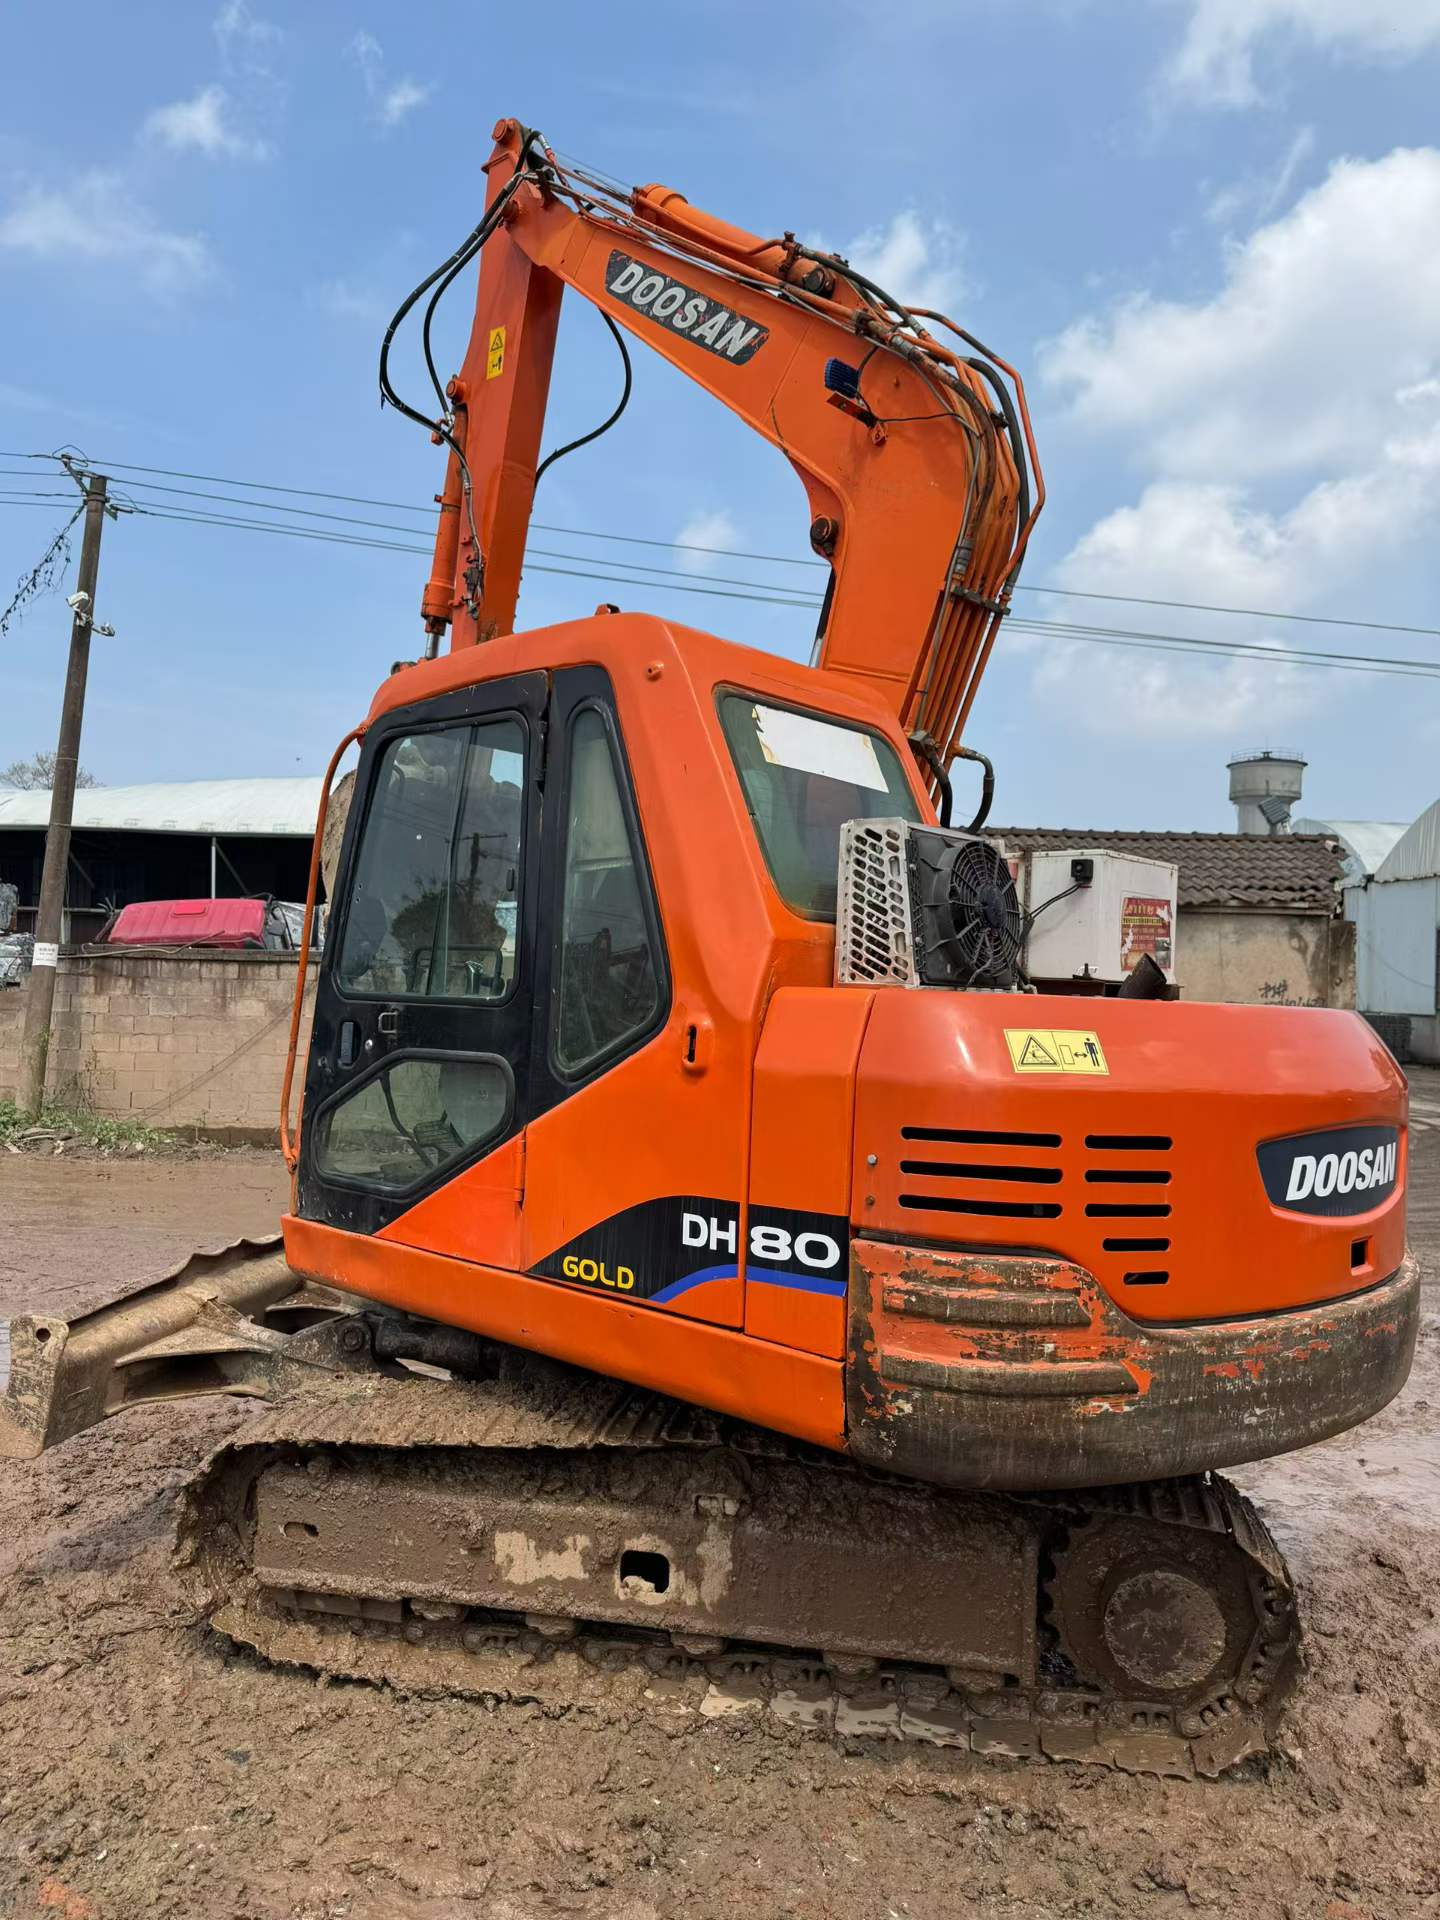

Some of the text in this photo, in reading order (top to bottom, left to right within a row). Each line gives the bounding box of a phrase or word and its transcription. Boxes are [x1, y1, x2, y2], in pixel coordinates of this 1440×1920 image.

[609, 262, 759, 357] DOOSAN
[1285, 1142, 1396, 1201] DOOSAN
[562, 1256, 634, 1290] GOLD
